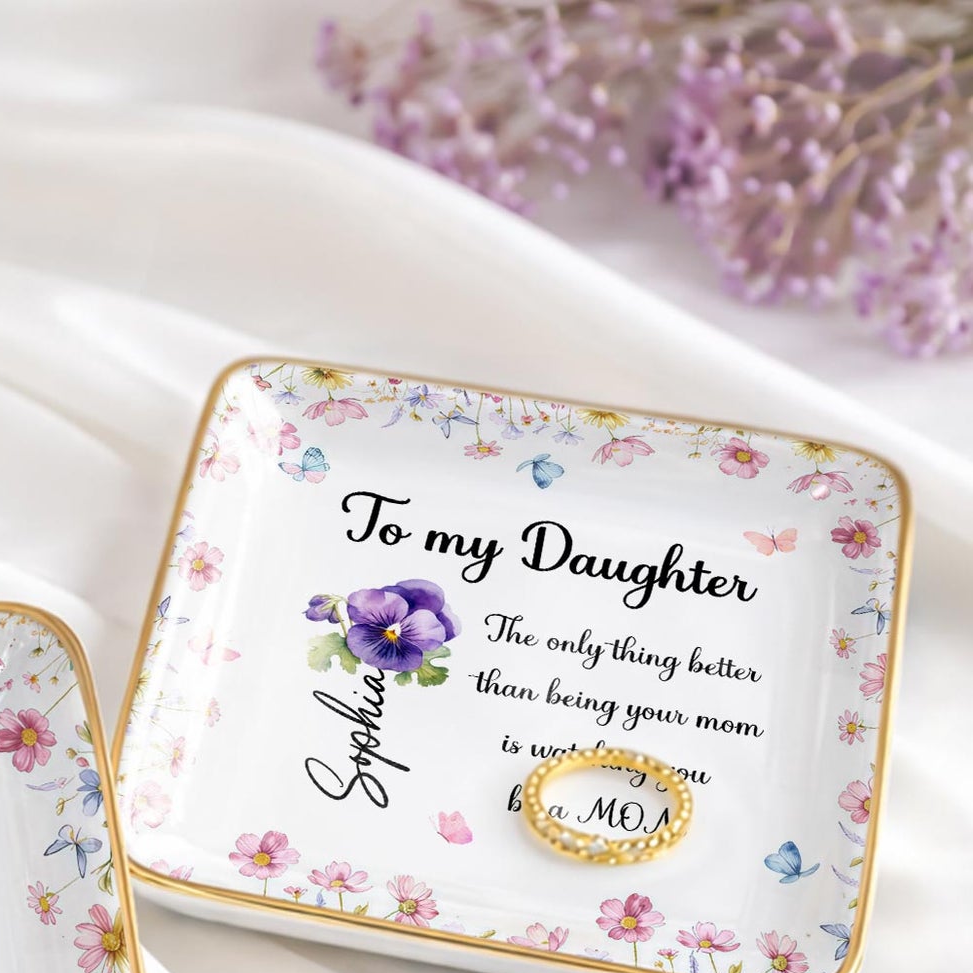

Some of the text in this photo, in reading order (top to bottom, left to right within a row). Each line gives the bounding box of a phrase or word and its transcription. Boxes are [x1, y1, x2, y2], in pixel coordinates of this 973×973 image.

[341, 491, 758, 610] To my Daughter
[484, 613, 763, 683] The only thing better
[468, 668, 765, 738] than being your mom
[304, 668, 411, 809] Sophia
[501, 734, 523, 755] is
[548, 803, 569, 820] a
